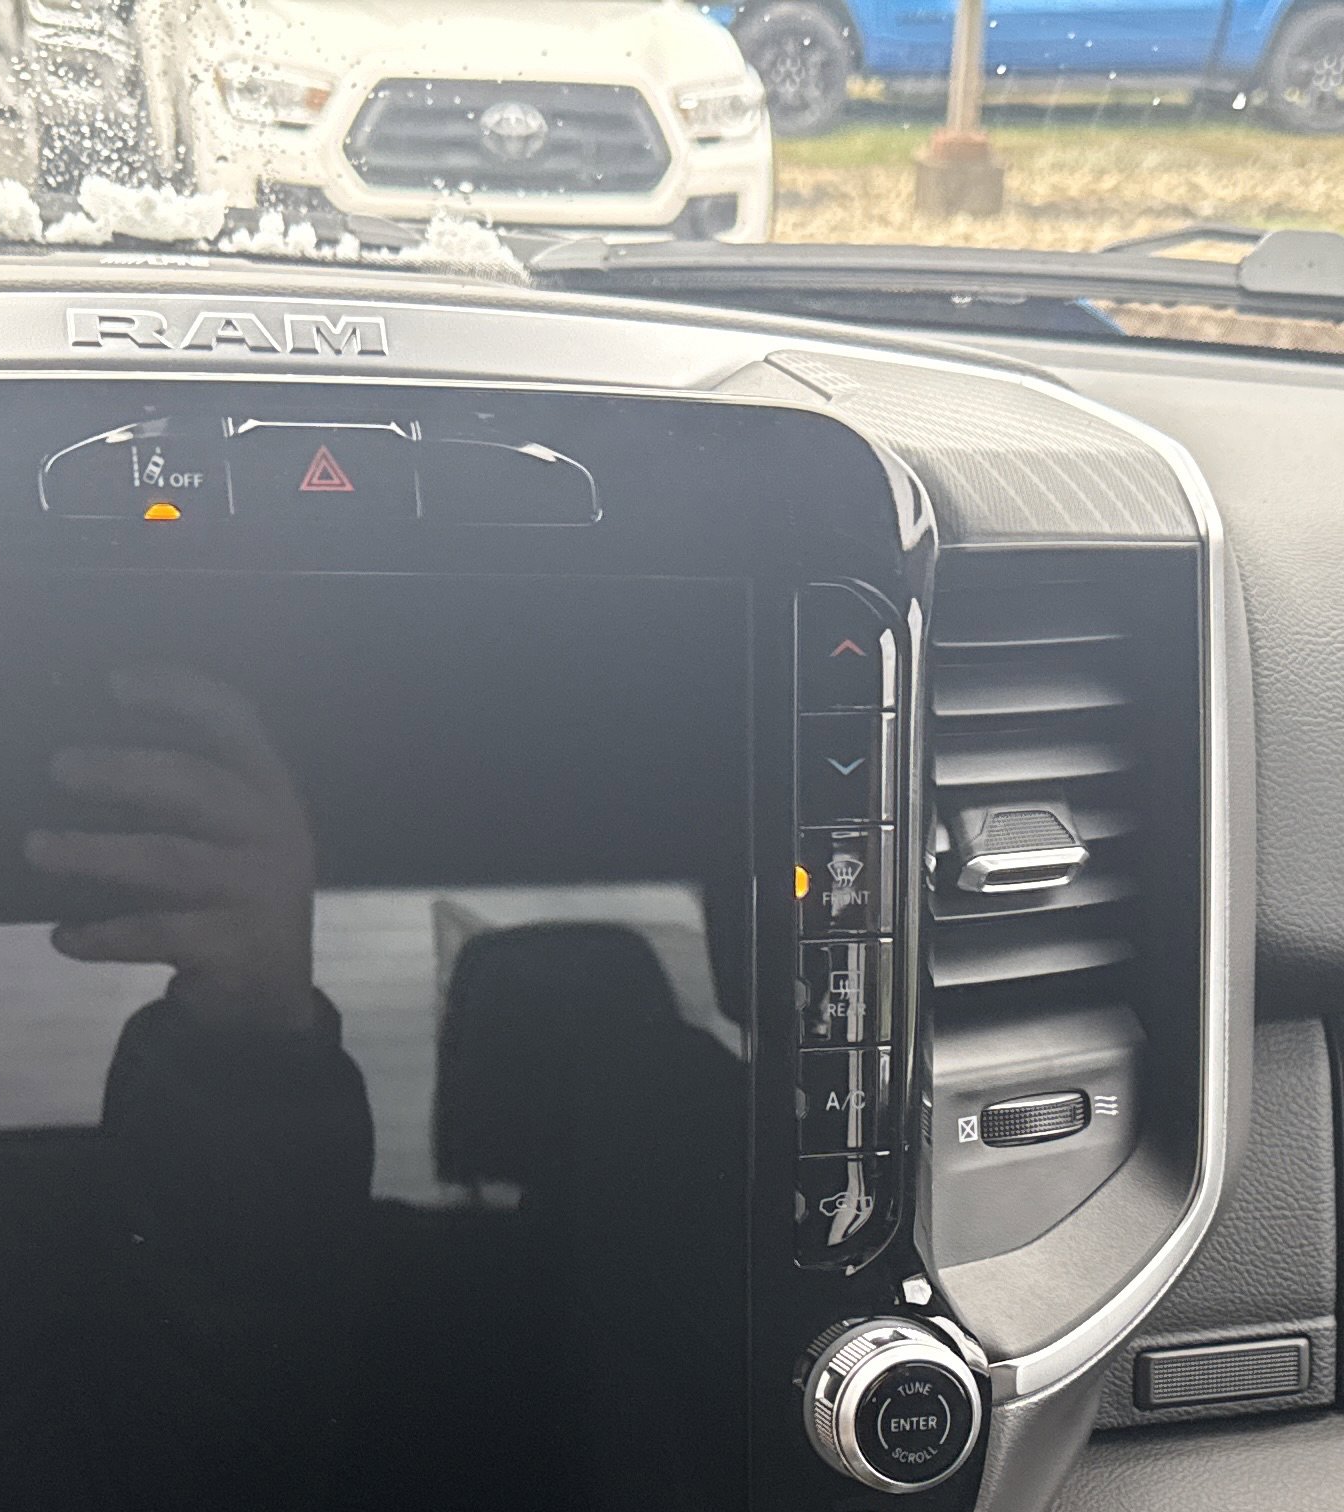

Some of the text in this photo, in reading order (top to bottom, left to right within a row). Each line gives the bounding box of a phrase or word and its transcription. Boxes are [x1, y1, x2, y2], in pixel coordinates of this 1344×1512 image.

[66, 308, 389, 356] RAM
[169, 473, 204, 488] OFF
[827, 1003, 867, 1017] RER
[826, 1090, 866, 1111] A/C
[897, 1382, 933, 1397] TUNE
[890, 1416, 938, 1432] ENTER
[892, 1445, 938, 1464] SCROLL
